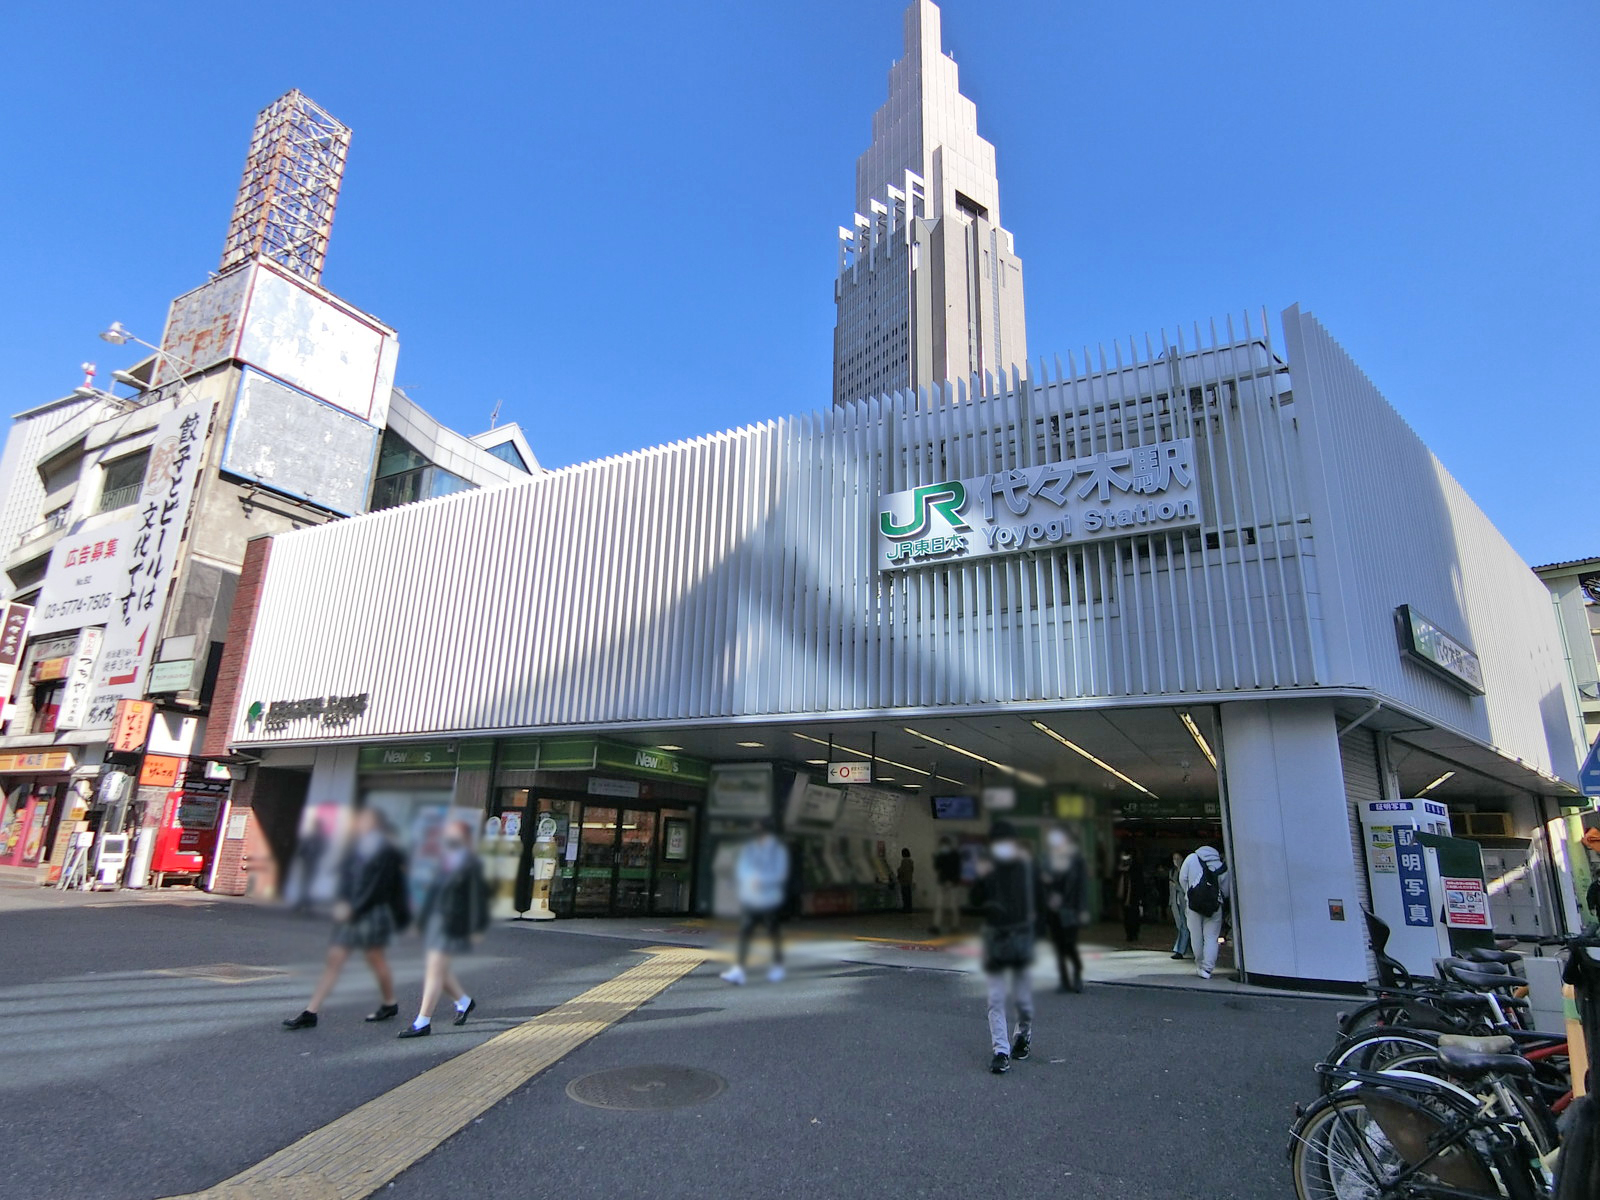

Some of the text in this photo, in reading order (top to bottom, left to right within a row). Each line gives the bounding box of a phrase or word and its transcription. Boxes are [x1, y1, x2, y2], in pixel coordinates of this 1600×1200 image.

[978, 439, 1191, 521] 代々木駅
[138, 412, 200, 612] 餃子とビールは
[879, 479, 972, 538] JR
[980, 495, 1195, 547] Yoyogi Station
[64, 537, 119, 568] 広告募集
[117, 501, 158, 626] 文化です。
[886, 533, 964, 561] JR東日本
[43, 592, 113, 619] 03-5774-7505
[74, 657, 92, 693] つちや
[1398, 829, 1428, 923] 証明写真
